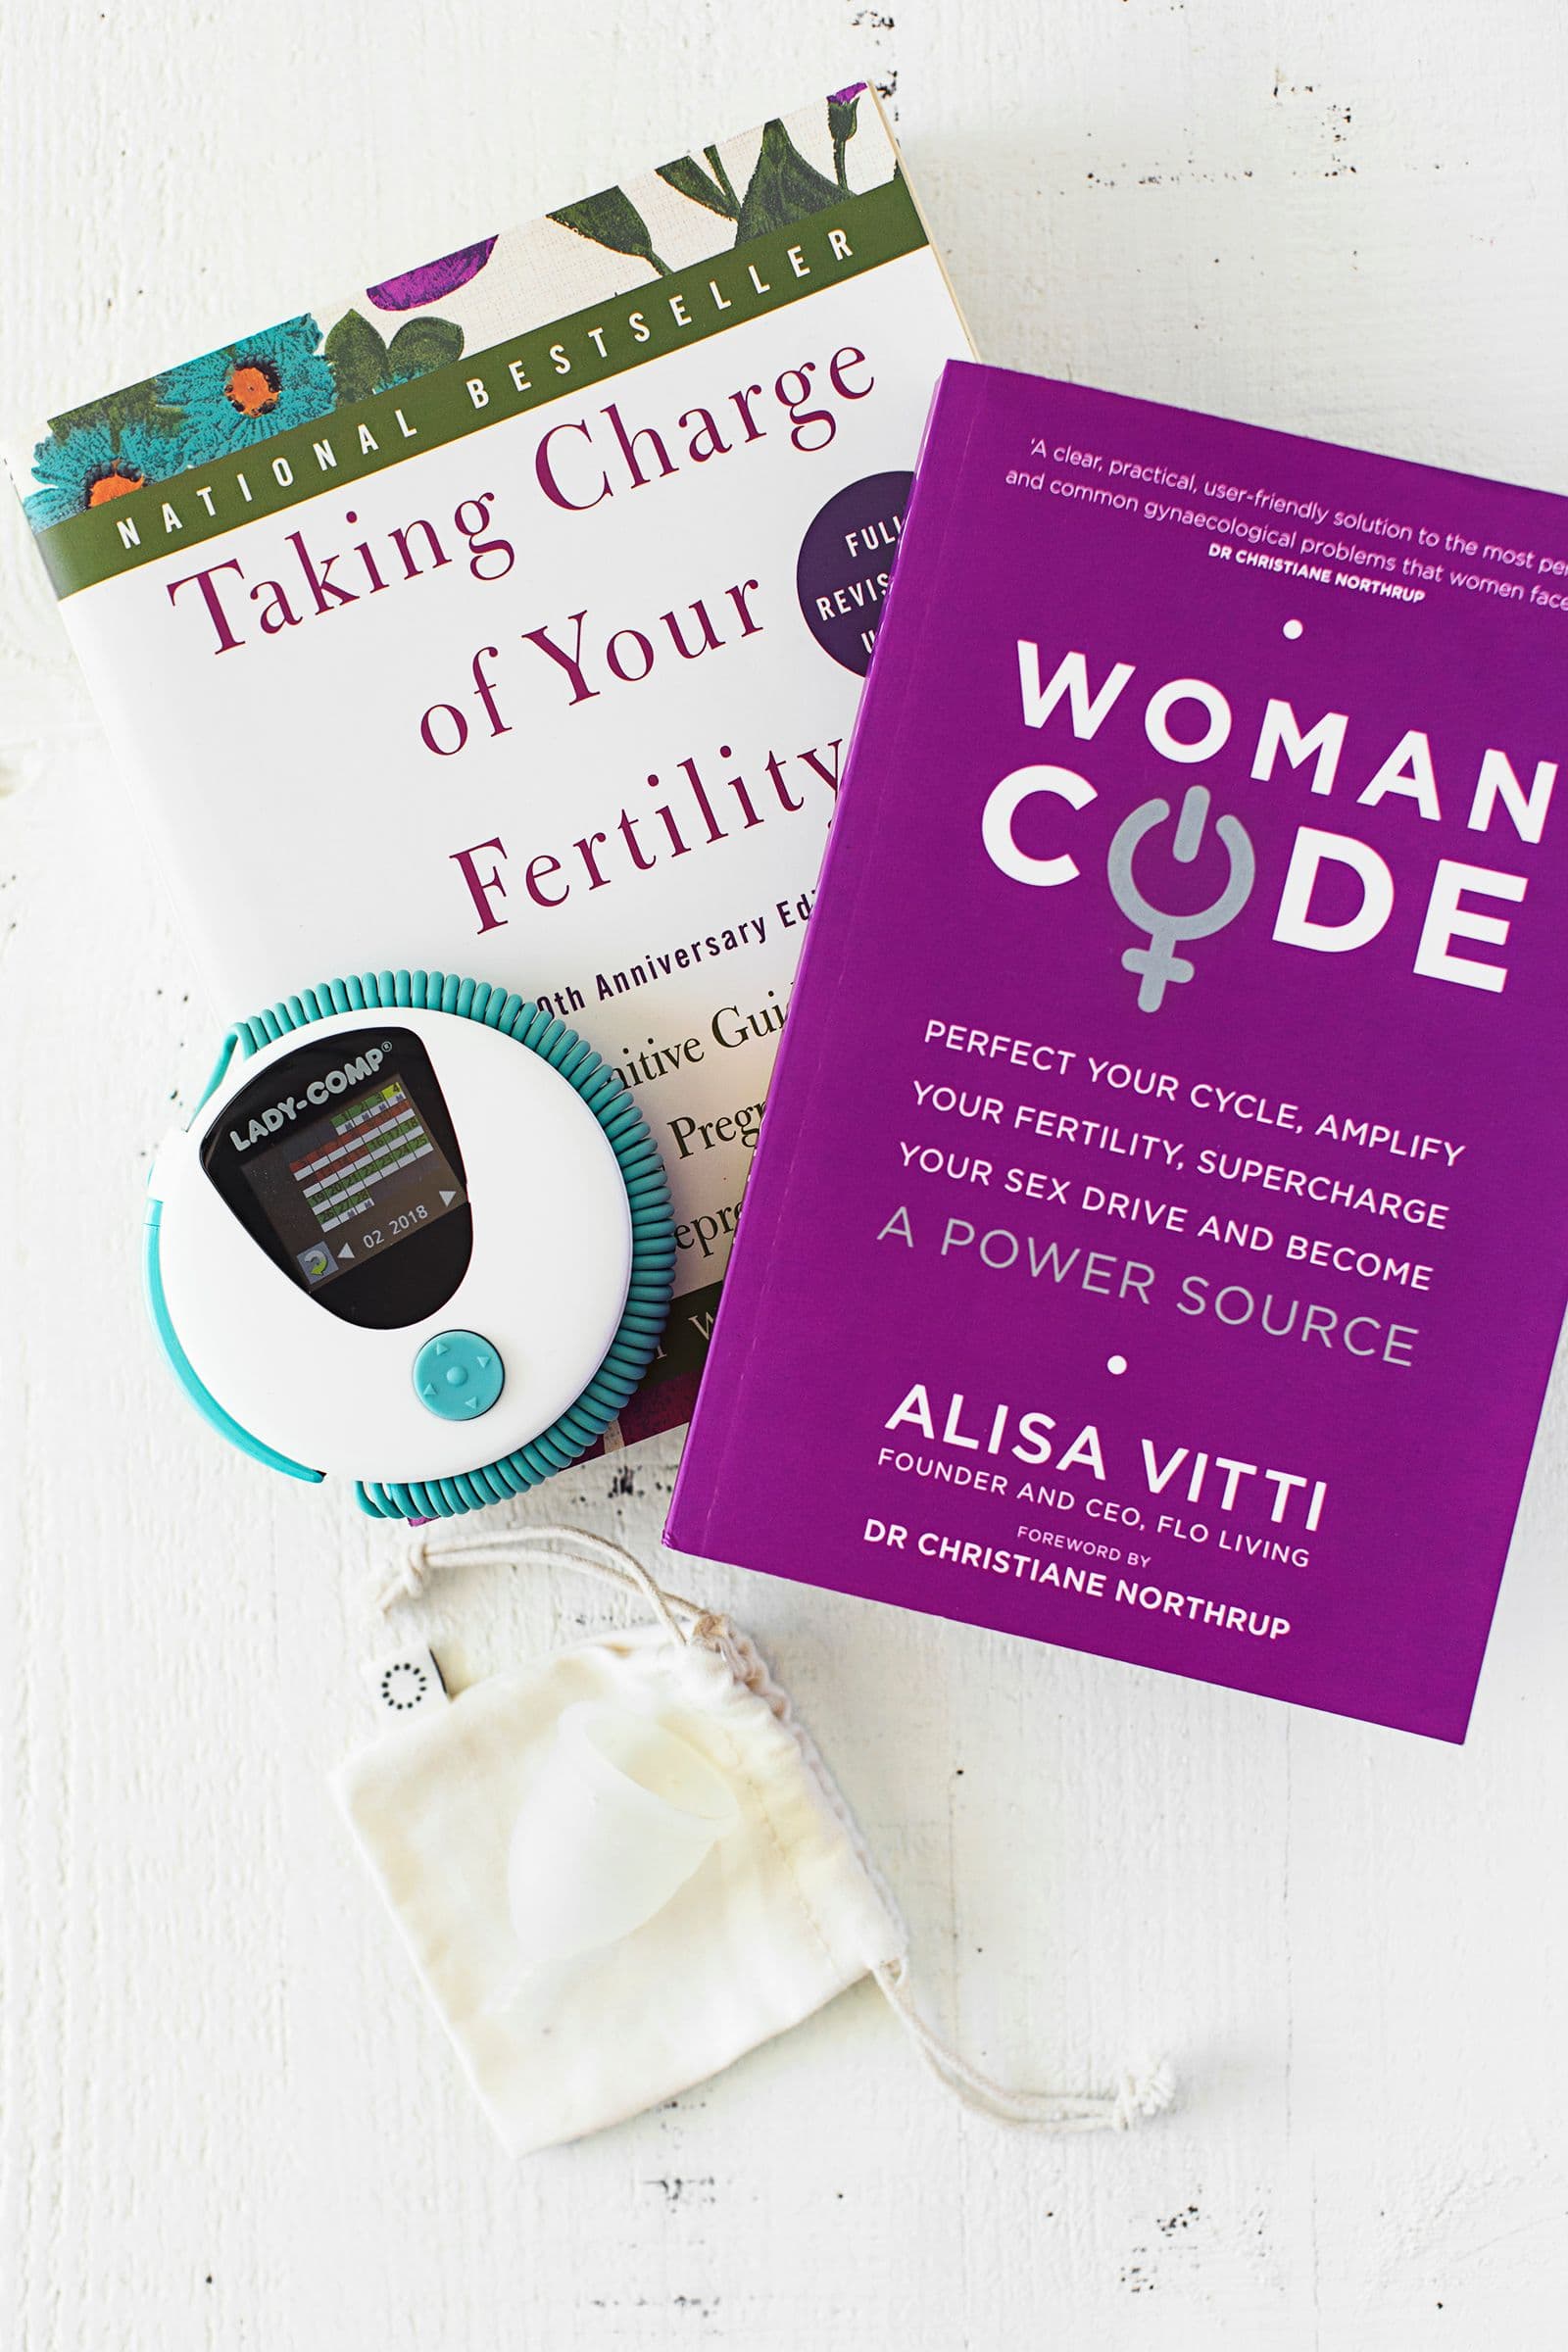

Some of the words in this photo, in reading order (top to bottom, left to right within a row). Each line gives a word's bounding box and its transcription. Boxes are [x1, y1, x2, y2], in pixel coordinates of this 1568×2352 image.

[116, 409, 417, 550] NATIONAL
[466, 229, 854, 410] BESTSELLER
[167, 492, 515, 656] Taking
[535, 346, 874, 511] Charge
[1004, 468, 1046, 491] and
[1049, 479, 1139, 513] common
[1144, 501, 1298, 549] gynaecological
[1299, 538, 1396, 571] problems
[1401, 558, 1445, 583] that
[1449, 571, 1525, 601] women
[1053, 445, 1102, 472] clear,
[1107, 460, 1198, 494] practical,
[1203, 481, 1330, 525] user-friendly
[1333, 512, 1413, 542] solution
[1418, 527, 1441, 548] to
[1445, 532, 1479, 556] the
[1482, 545, 1536, 569] most
[1207, 542, 1233, 561] DR
[1235, 549, 1333, 584] CHRISTIANE
[1334, 571, 1426, 604] NORTHRUP
[420, 646, 513, 756] of
[520, 579, 763, 707] Your
[1016, 639, 1559, 845] WOMAN
[449, 738, 844, 935] Fertility
[595, 916, 766, 1002] Anniversary
[776, 889, 816, 928] Ed
[711, 982, 793, 1049] Gui
[913, 1080, 1004, 1125] YOUR
[1013, 1104, 1185, 1171] FERTILITY,
[1196, 1149, 1450, 1230] SUPERCHARGE
[924, 1019, 1077, 1075] PERFECT
[1088, 1056, 1180, 1102] YOUR
[1190, 1083, 1303, 1135] CYCLE,
[1314, 1113, 1466, 1167] AMPLIFY
[363, 1230, 384, 1249] 02
[388, 1204, 429, 1235] 2018
[876, 1205, 914, 1249] A
[940, 1217, 1155, 1305] POWER
[1176, 1275, 1419, 1367] SOURCE
[900, 1141, 993, 1187] YOUR
[1004, 1167, 1071, 1205] SEX
[1081, 1186, 1189, 1233] DRIVE
[1197, 1215, 1274, 1251] AND
[1285, 1234, 1435, 1292] BECOME
[877, 1446, 1008, 1495] FOUNDER
[1015, 1482, 1075, 1510] AND
[1085, 1497, 1146, 1532] CEO,
[1156, 1514, 1209, 1544] FLO
[1218, 1529, 1310, 1568] LIVING
[884, 1383, 1106, 1481] ALISA
[1141, 1438, 1328, 1532] VITTI
[862, 1518, 908, 1549] DR
[917, 1532, 1107, 1597] CHRISTIANE
[1114, 1579, 1291, 1640] NORTHRUP
[1016, 1525, 1122, 1561] FOREWORD
[1127, 1551, 1152, 1568] BY
